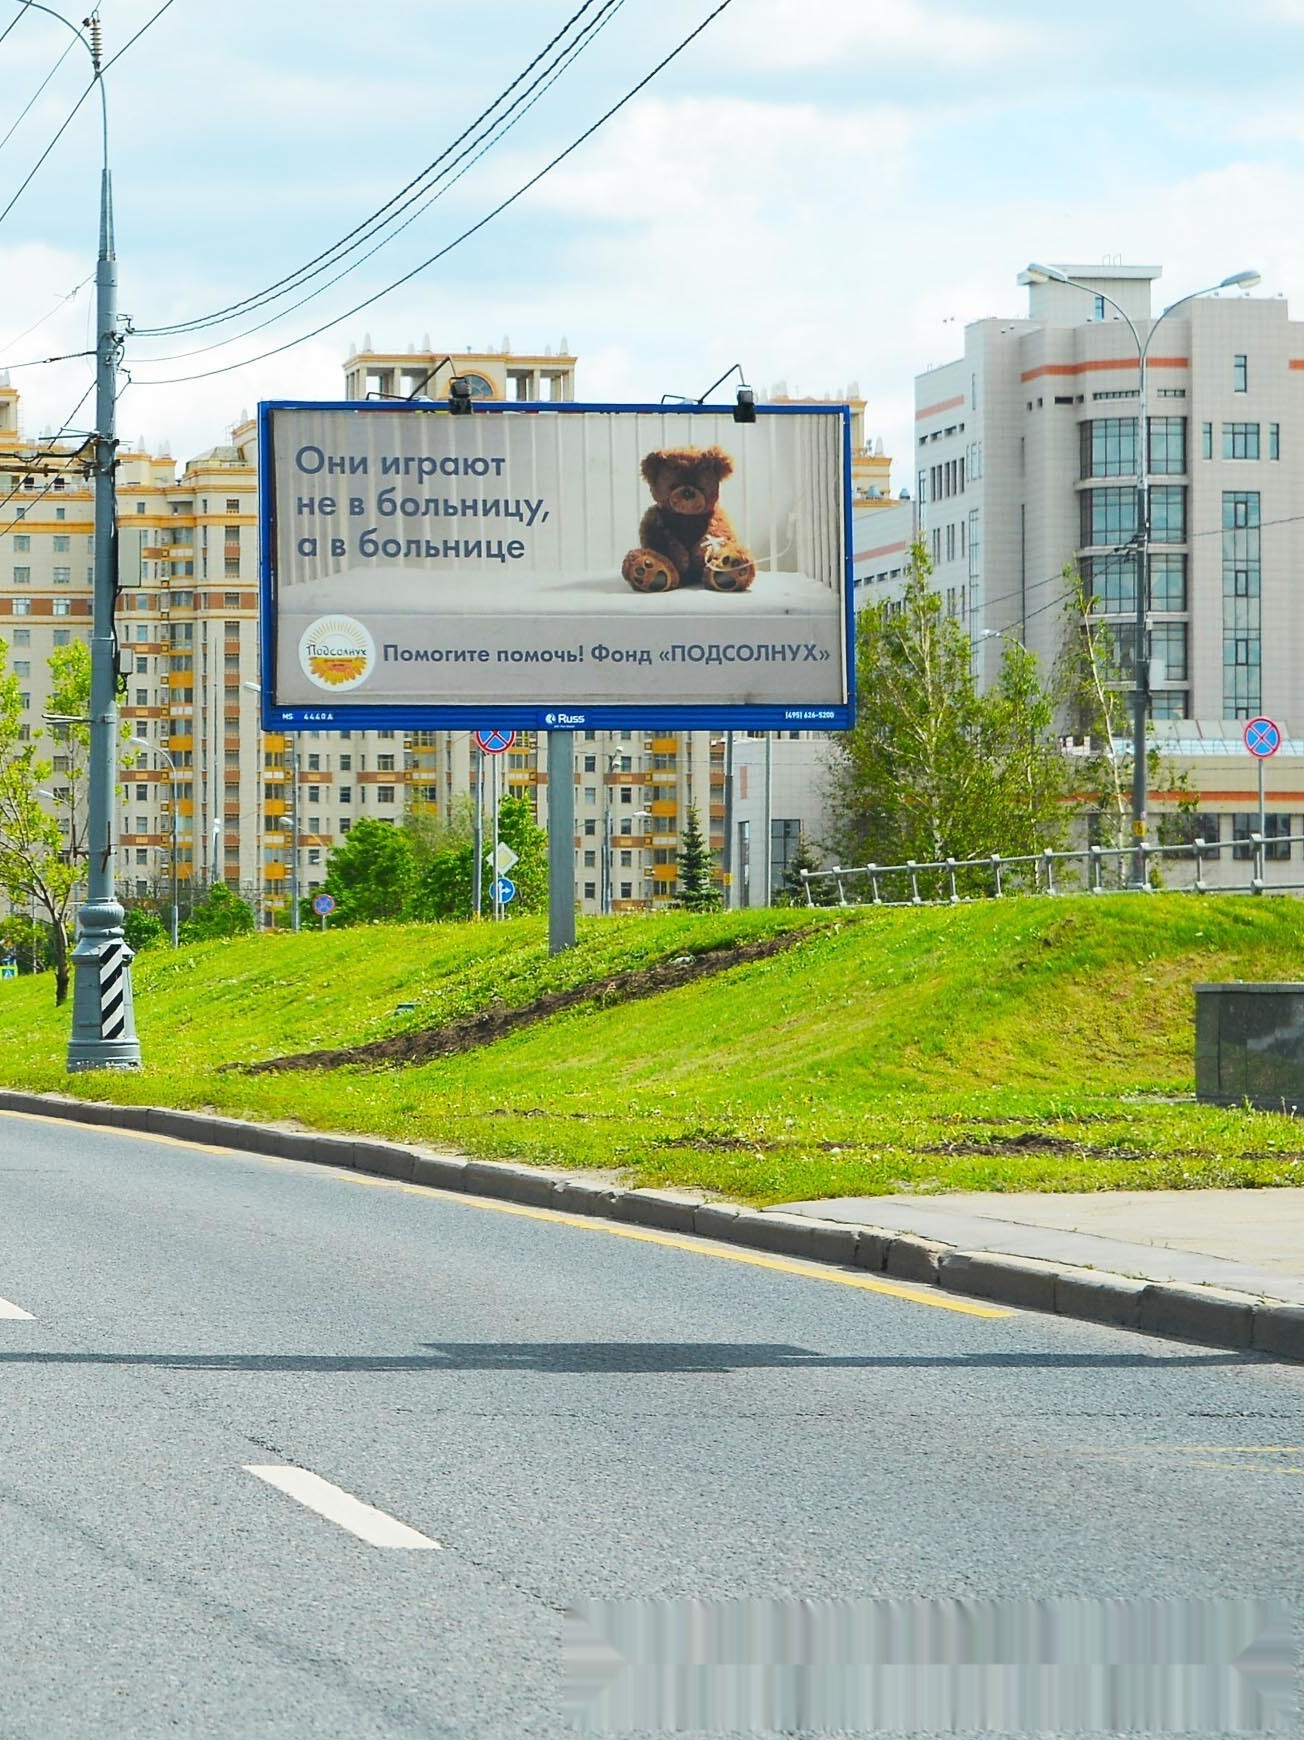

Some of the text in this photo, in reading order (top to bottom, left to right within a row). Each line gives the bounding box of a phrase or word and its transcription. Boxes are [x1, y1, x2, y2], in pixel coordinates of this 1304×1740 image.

[295, 445, 506, 485] Они играют
[296, 486, 550, 527] не в больницу,
[297, 527, 525, 564] а в больнице
[383, 643, 830, 665] Помогите помочь! Фонд «ПОДСОЛНУХ»
